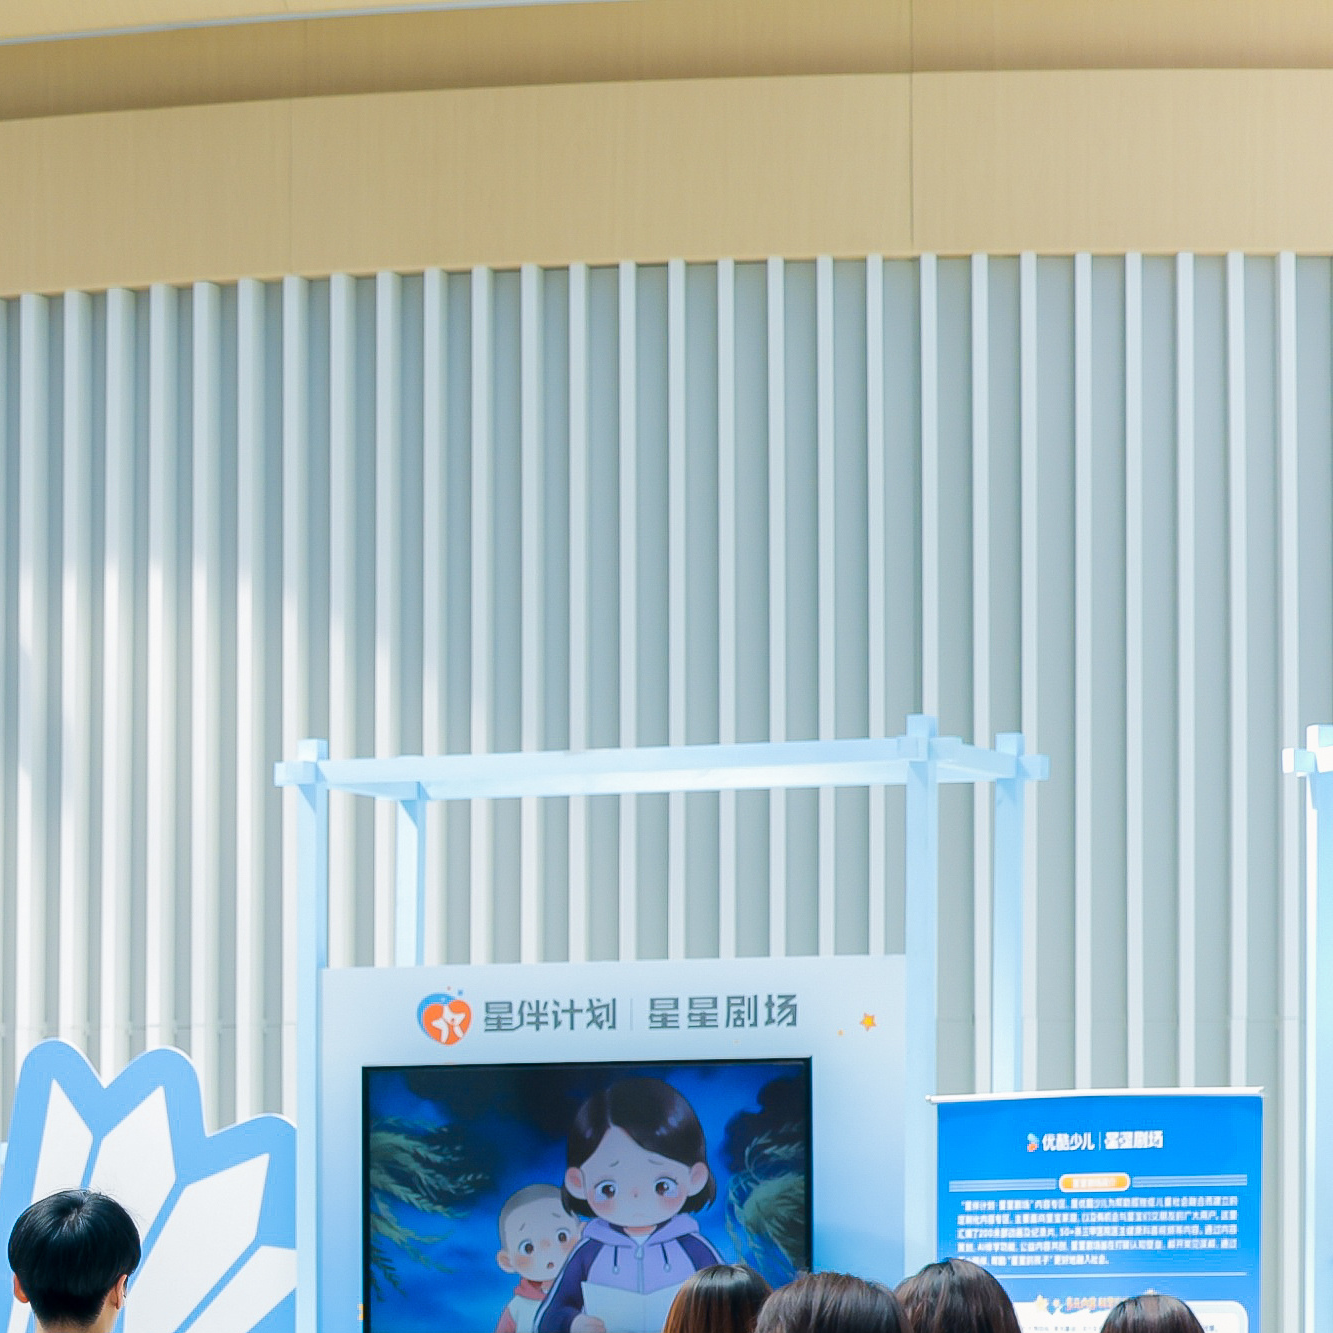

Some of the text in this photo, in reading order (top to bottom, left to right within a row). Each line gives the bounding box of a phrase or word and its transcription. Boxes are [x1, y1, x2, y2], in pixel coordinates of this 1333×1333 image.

[484, 994, 798, 1033] 星伴计划 星星剧场
